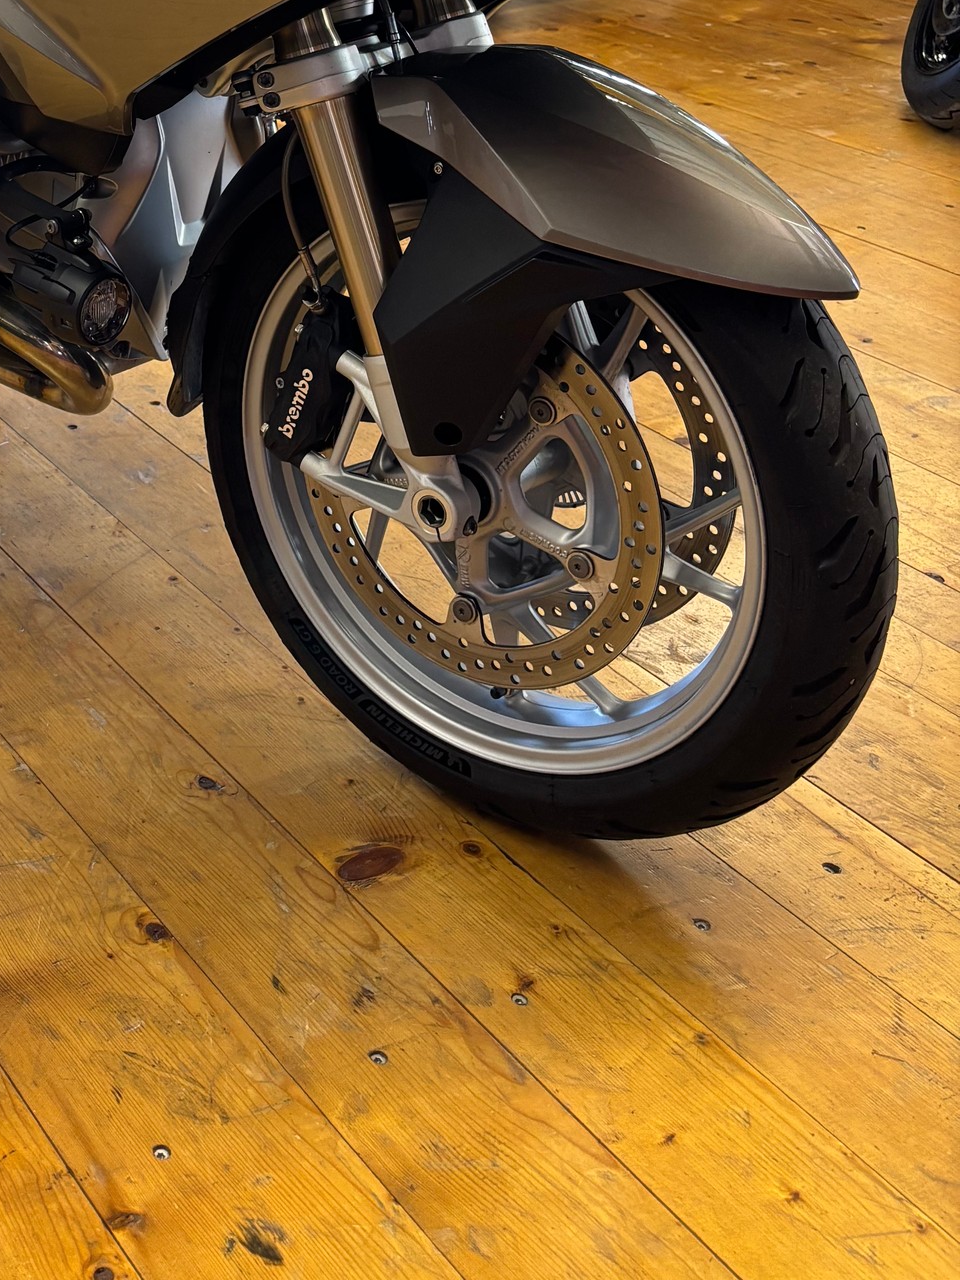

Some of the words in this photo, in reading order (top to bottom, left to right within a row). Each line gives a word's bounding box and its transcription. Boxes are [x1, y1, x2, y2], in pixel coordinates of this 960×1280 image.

[278, 368, 314, 439] brembo
[295, 620, 312, 643] GT
[318, 657, 356, 694] ROAD
[366, 704, 444, 761] MICHELIN
